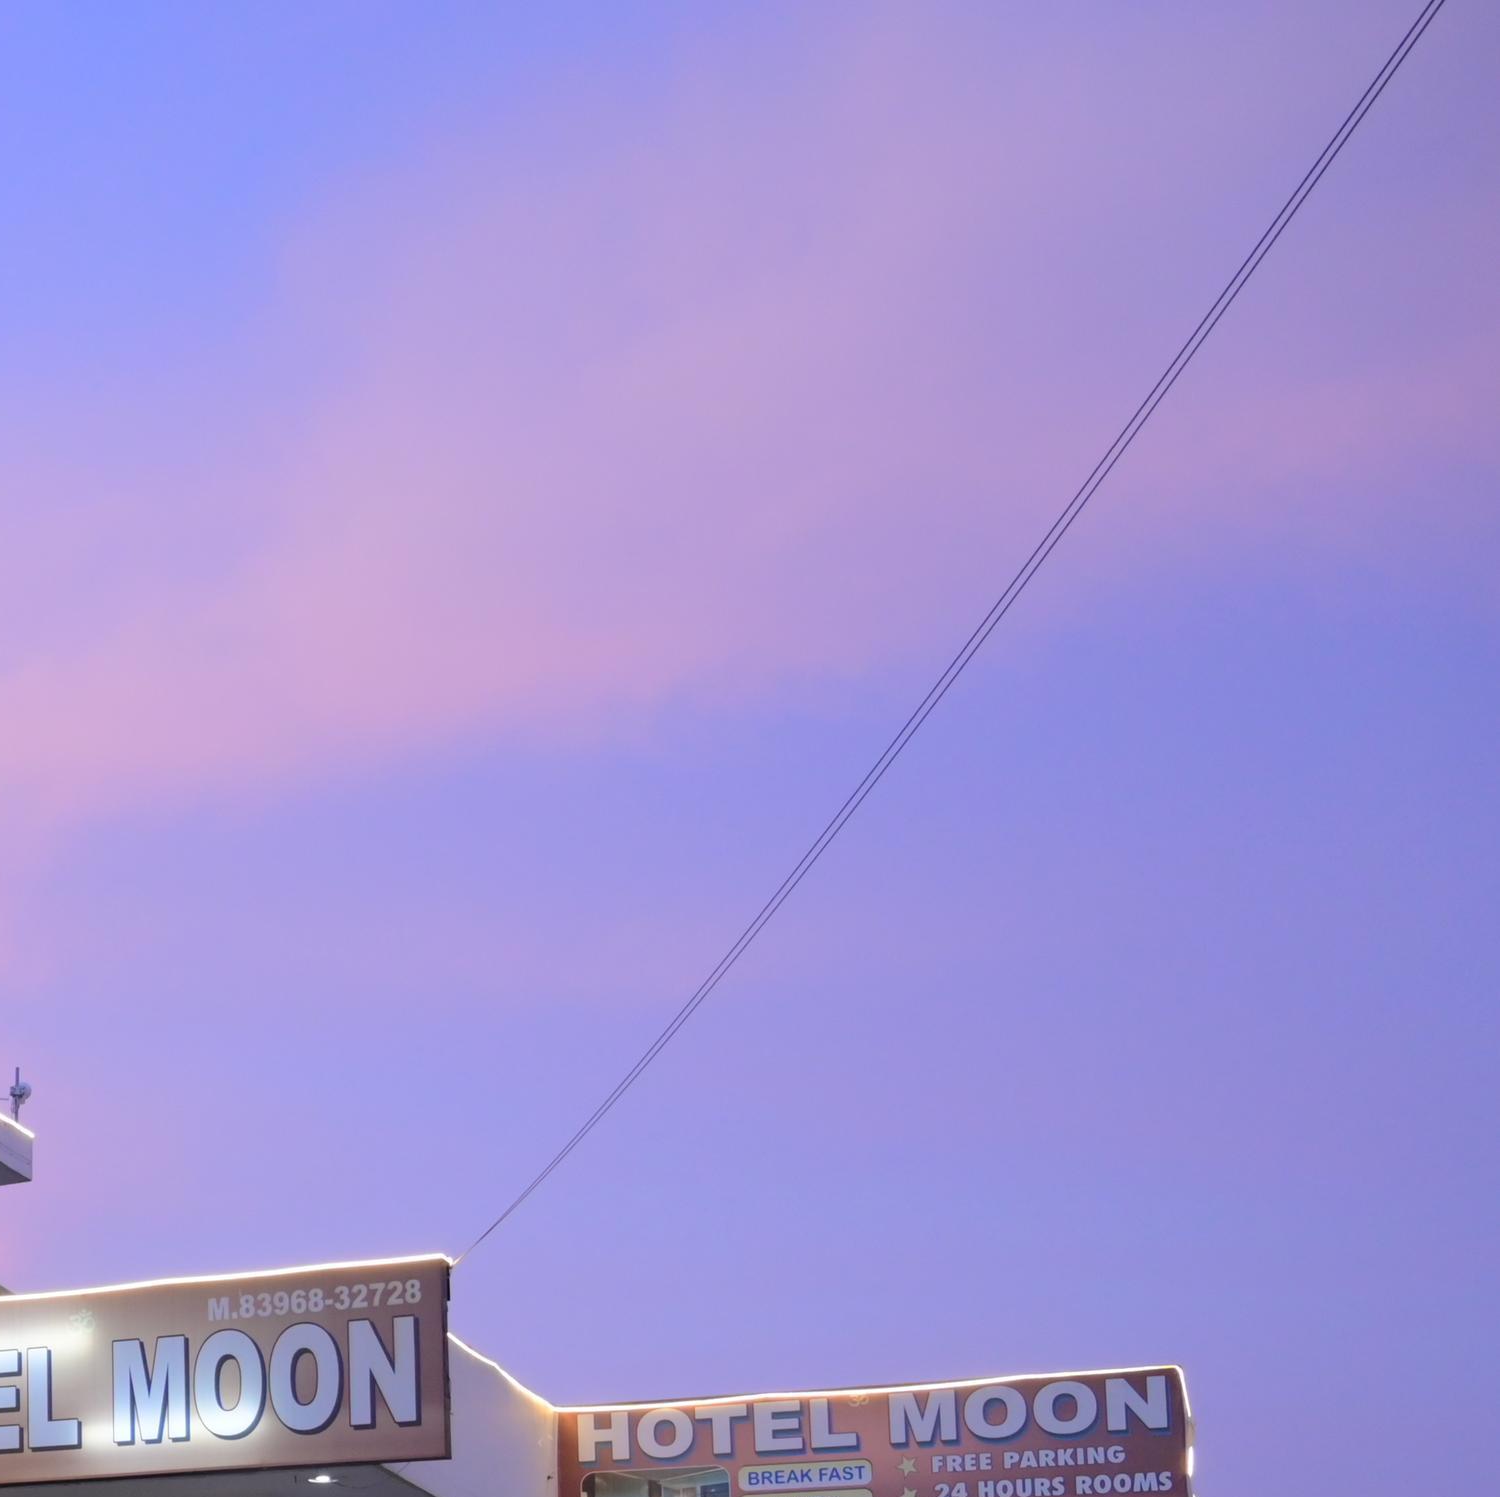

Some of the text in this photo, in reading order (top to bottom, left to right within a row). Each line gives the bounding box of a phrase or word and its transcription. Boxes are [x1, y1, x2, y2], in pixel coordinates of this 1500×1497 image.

[206, 1278, 423, 1322] M.83968-32728
[111, 1314, 422, 1445] MOON
[577, 1374, 1170, 1463] HOTEL MOON
[748, 1465, 866, 1486] BREAK FAST
[931, 1446, 1127, 1473] FREE PARKING
[1075, 1471, 1173, 1496] ROOMS
